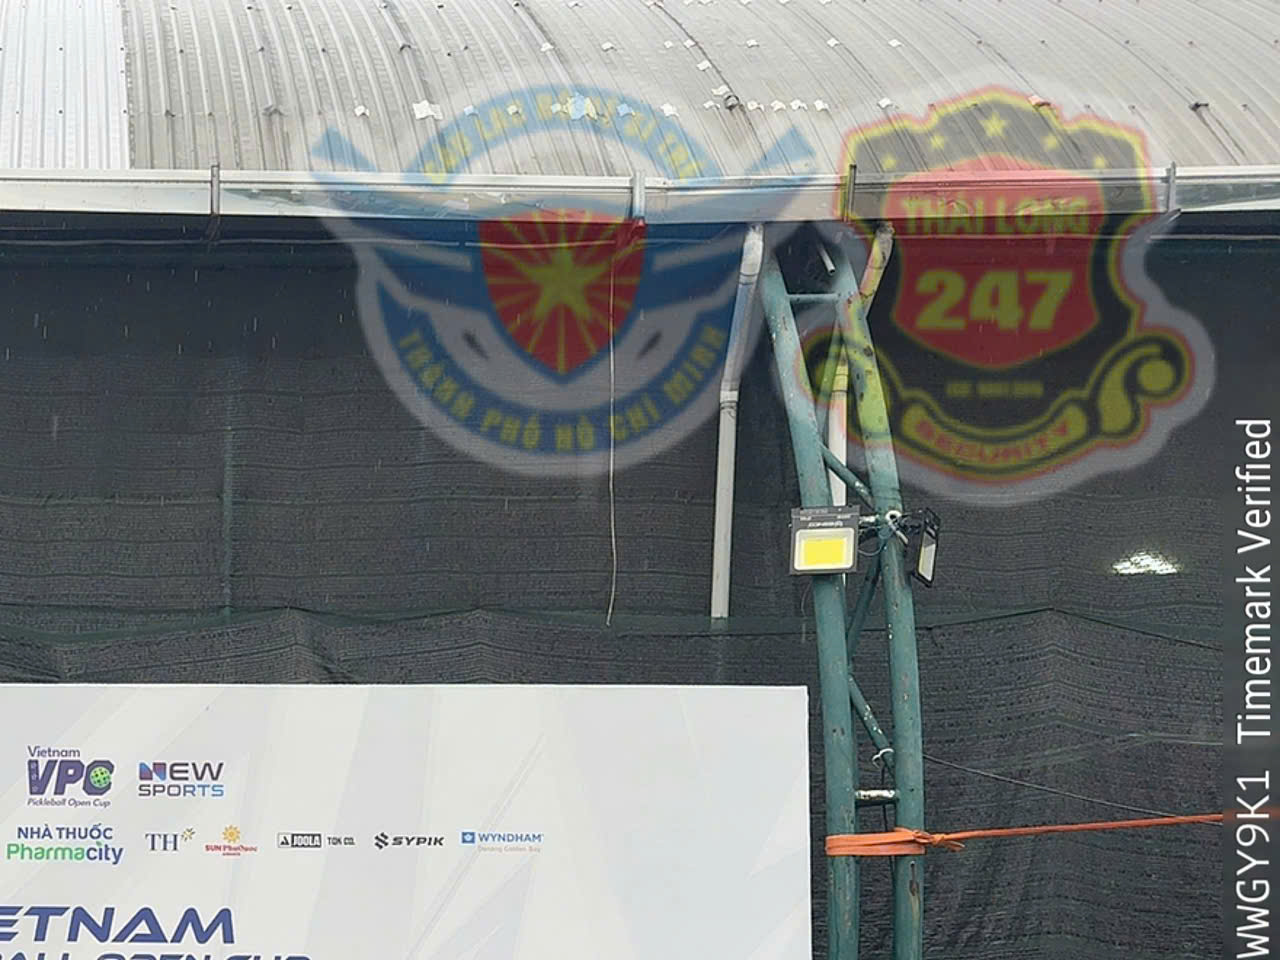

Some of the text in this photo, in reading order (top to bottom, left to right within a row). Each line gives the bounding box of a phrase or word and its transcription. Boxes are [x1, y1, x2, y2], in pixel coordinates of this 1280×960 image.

[27, 745, 81, 758] Vietnam
[138, 762, 224, 781] NEW
[138, 784, 225, 797] SPORTS
[27, 798, 111, 809] Pickleball Open Cup
[18, 823, 113, 840] NHÀ THUỐC
[478, 833, 542, 843] WYNDHAM
[145, 833, 180, 852] TH
[391, 836, 445, 846] SYPIK
[6, 842, 124, 865] Pharmacity
